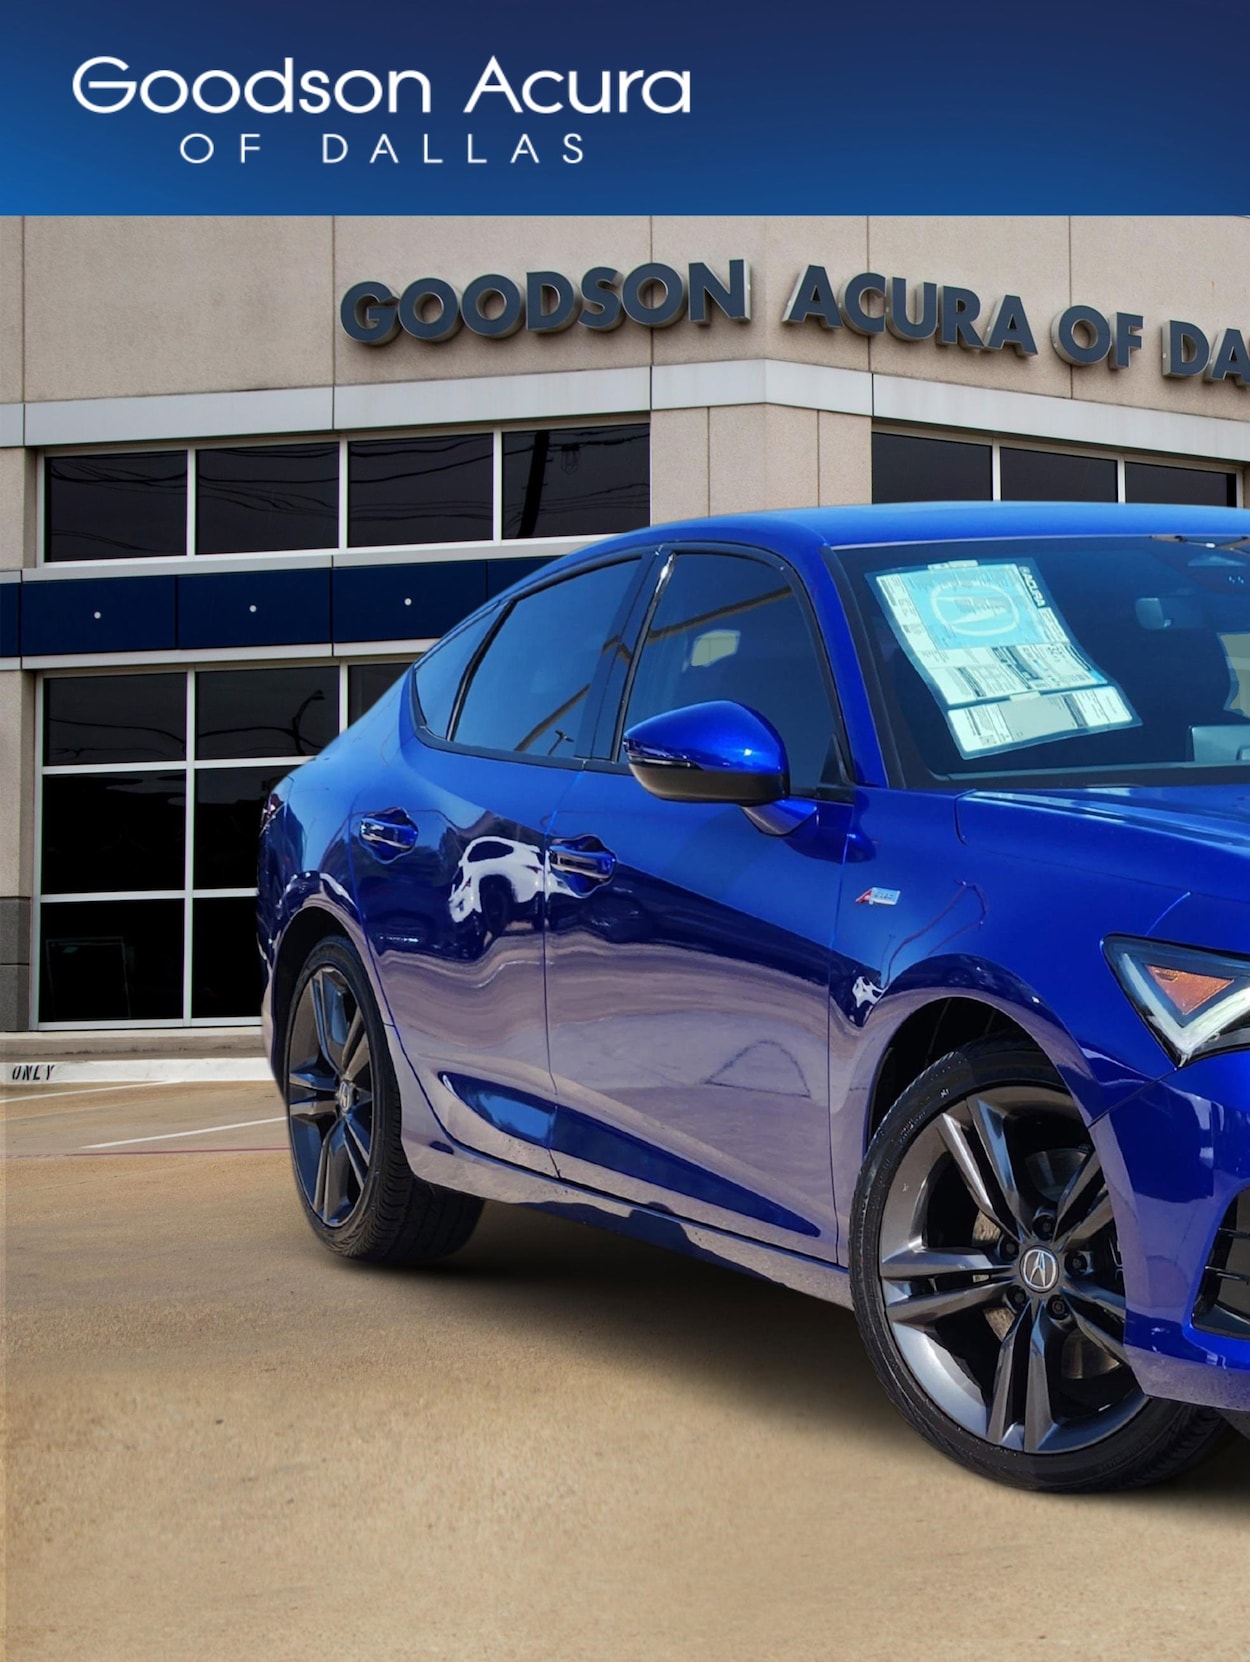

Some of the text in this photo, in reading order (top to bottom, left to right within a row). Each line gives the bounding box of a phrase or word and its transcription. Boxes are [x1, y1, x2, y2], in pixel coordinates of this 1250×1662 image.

[340, 259, 751, 346] GOODSON
[782, 264, 1038, 356] ACURA
[1050, 305, 1144, 369] OF
[12, 1064, 55, 1081] ONLY
